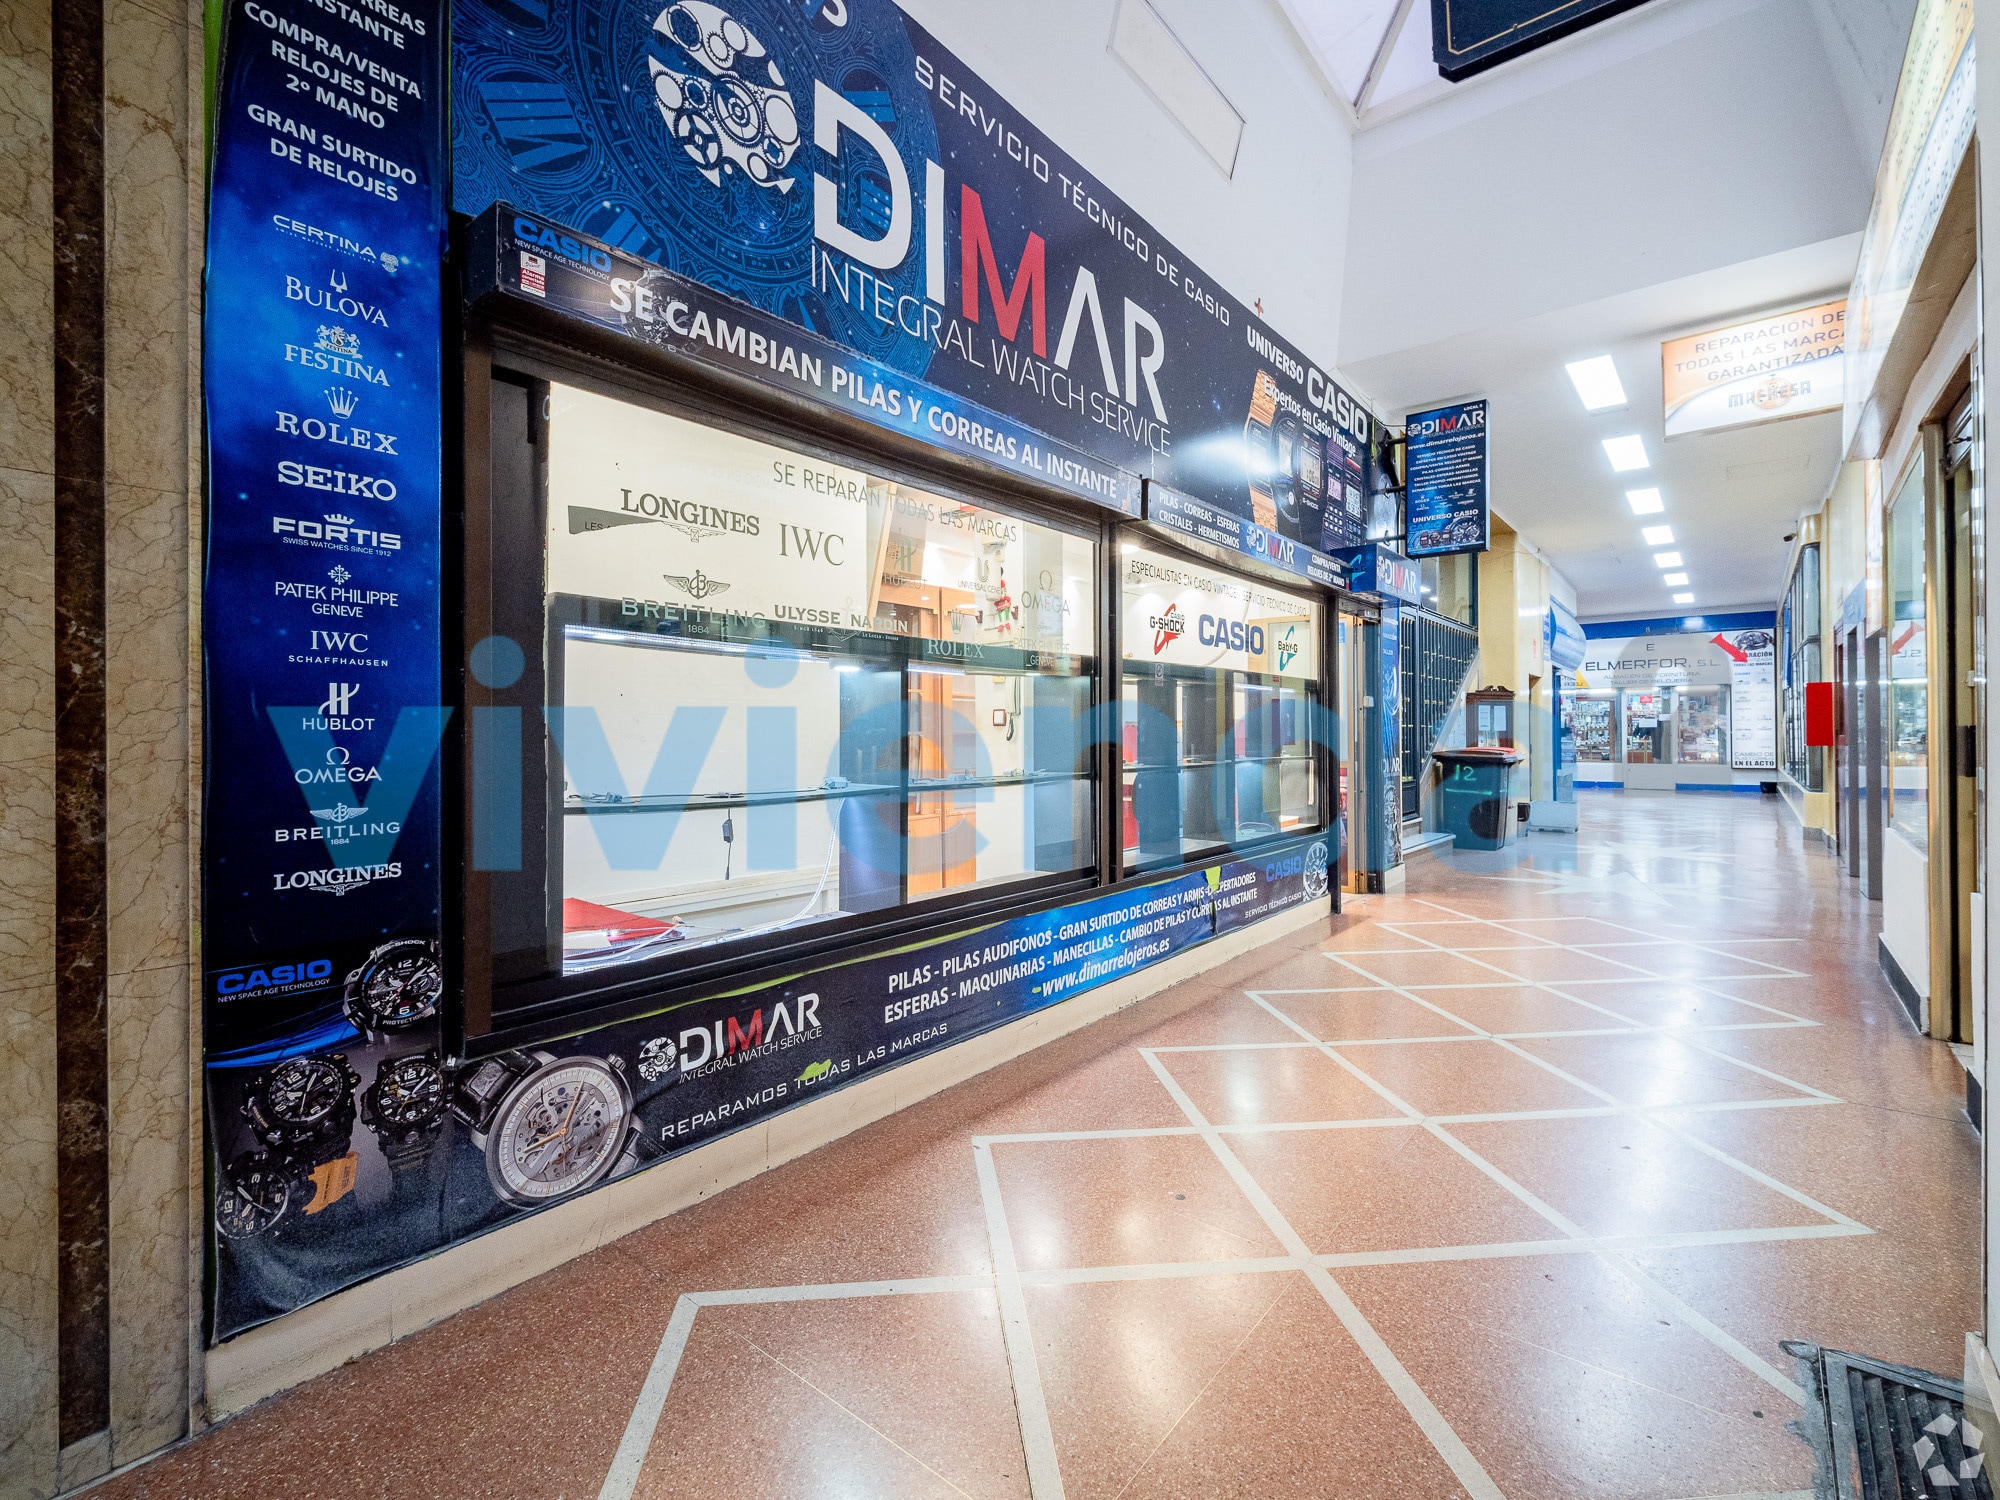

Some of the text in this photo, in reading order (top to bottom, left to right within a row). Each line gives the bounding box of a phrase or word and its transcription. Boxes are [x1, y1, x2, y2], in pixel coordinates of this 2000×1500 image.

[244, 1, 422, 100] COMPRA/VENTA
[271, 39, 399, 113] RELOJES DE
[316, 86, 385, 129] MANO
[248, 103, 417, 185] GRAN SURTIDO
[270, 138, 399, 202] DE RELOJES
[914, 55, 1230, 327] SERVICIO TÉCNICO DE CASIO
[273, 214, 377, 259] CERTINA
[513, 217, 612, 272] CASIO
[813, 78, 1169, 425] DIMAR
[514, 238, 530, 249] NEW
[531, 244, 553, 259] SPACE
[553, 254, 567, 265] AGE
[567, 260, 610, 281] TECHNOLOGY
[285, 275, 389, 328] BULOVA
[811, 244, 1171, 458] INTEGRAL WATCH SERVICE
[1695, 310, 1845, 353] REPARACIÓN DE
[284, 343, 391, 387] FESTINA
[1674, 352, 1734, 373] TODAS
[1741, 343, 1776, 359] LAS
[1708, 345, 1844, 381] GARANTIZADA
[610, 277, 1117, 498] SE CAMBIAN PILAS Y CORREAS AL INSTANTE
[1247, 325, 1367, 443] UNIVERSO CASIO
[275, 410, 399, 455] ROLEX
[1264, 375, 1356, 458] Expertos en Casio Vintage
[1422, 410, 1484, 434] DIMAR
[277, 461, 397, 501] SEIKO
[620, 488, 760, 536] LONGINES
[773, 461, 1016, 543] SE REPARAN TODAS LAS MARCAS
[1159, 492, 1240, 534] PILAS CORREAS ESFERAS
[1413, 509, 1478, 523] UNIVERSO CASIO
[273, 516, 401, 550] FORTIS
[779, 522, 844, 567] IWC
[1159, 509, 1240, 549] CRISTALES HERMETISMOS
[1409, 522, 1441, 531] CASIO
[283, 537, 392, 557] SWISS WATCHES SINCE 1912
[1256, 530, 1294, 564] DIMAR
[275, 582, 399, 607] PATEK PHILIPPE
[1131, 560, 1182, 584] ESPECIALISTAS
[1183, 574, 1192, 586] EN
[1194, 578, 1212, 593] CASIO
[1386, 558, 1417, 596] DIMAR
[312, 602, 364, 618] GENEVE
[621, 597, 766, 629] BREITLING
[774, 604, 908, 633] ULYSSE NARDIN
[1022, 591, 1070, 615] OMEGA
[1170, 612, 1185, 621] CASIO
[310, 630, 369, 653] IWC
[688, 624, 709, 634] 1884
[1150, 615, 1185, 634] G-SHOCK
[1199, 614, 1265, 655] CASIO
[288, 655, 388, 667] SCHAFFHAUSEN
[927, 639, 984, 658] ROLEX
[1586, 658, 1691, 671] ELMERFOR,
[302, 718, 375, 730] HUBLOT
[295, 767, 382, 784] OMEGA
[1454, 764, 1477, 781] 12
[275, 822, 400, 842] BREITLING
[273, 862, 402, 890] LONGINES
[1266, 856, 1301, 882] CASIO
[1245, 892, 1301, 919] SERVICIO TÉCNICO CASIO
[884, 986, 949, 1025] ESFERAS
[959, 955, 1046, 999] MAQUINARIAS
[1053, 933, 1114, 967] MANECILLAS
[1119, 920, 1154, 945] CAMBIO
[1154, 917, 1165, 935] DE
[1165, 909, 1186, 930] PILAS
[1186, 906, 1193, 921] Y
[1222, 897, 1230, 909] AL
[1231, 888, 1257, 906] INSTANTE
[888, 888, 1204, 994] PILAS PILAS AUDIFONOS GRAN SURTIDO DE CORREAS Y ARMIS
[217, 959, 332, 995] CASIO
[1041, 935, 1170, 998] www.dimarrelojeros.es
[218, 978, 330, 1003] NEW SPACE AGE TECHNOLOGY
[680, 992, 822, 1071] DIMAR
[679, 1026, 822, 1084] INTEGRAL WATCH SERVICE
[661, 1083, 788, 1142] REPARAMOS
[857, 1045, 886, 1066] LAS
[891, 1022, 948, 1052] MARCAS
